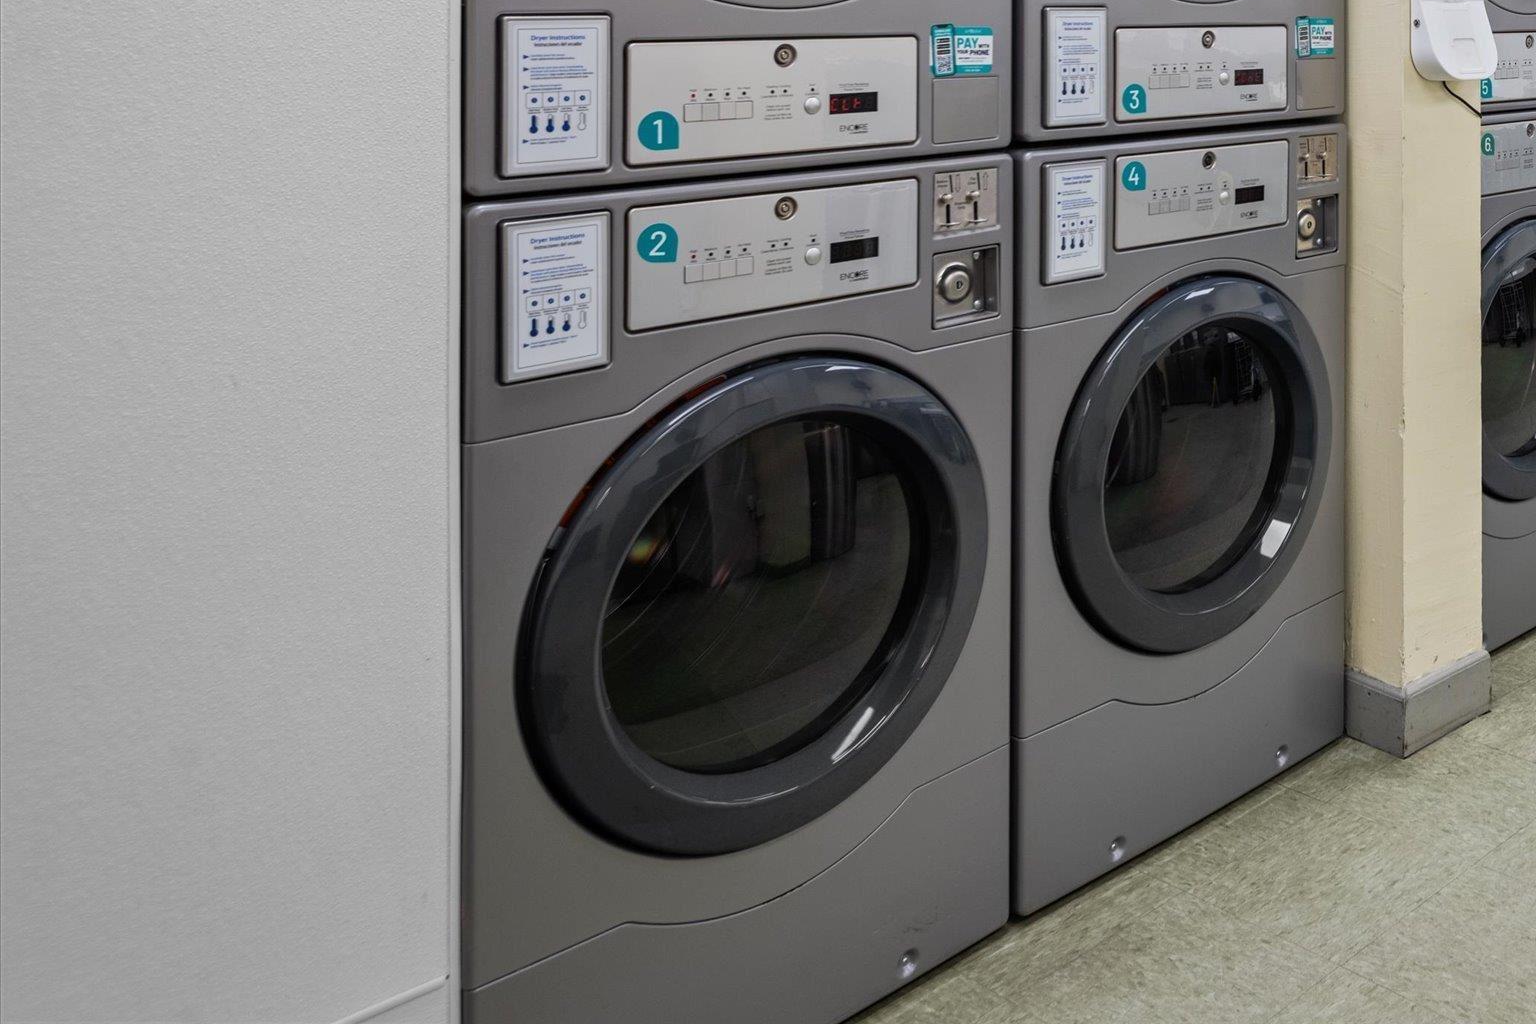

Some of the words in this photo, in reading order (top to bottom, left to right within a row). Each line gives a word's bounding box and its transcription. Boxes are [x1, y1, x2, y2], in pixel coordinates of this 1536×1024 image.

[1311, 26, 1325, 36] PAY
[957, 37, 979, 48] PAY
[1481, 80, 1489, 95] 5
[1129, 89, 1140, 110] 3
[652, 119, 663, 144] 1
[1128, 166, 1140, 186] 4
[530, 237, 548, 245] Dryer
[649, 230, 667, 256] 2
